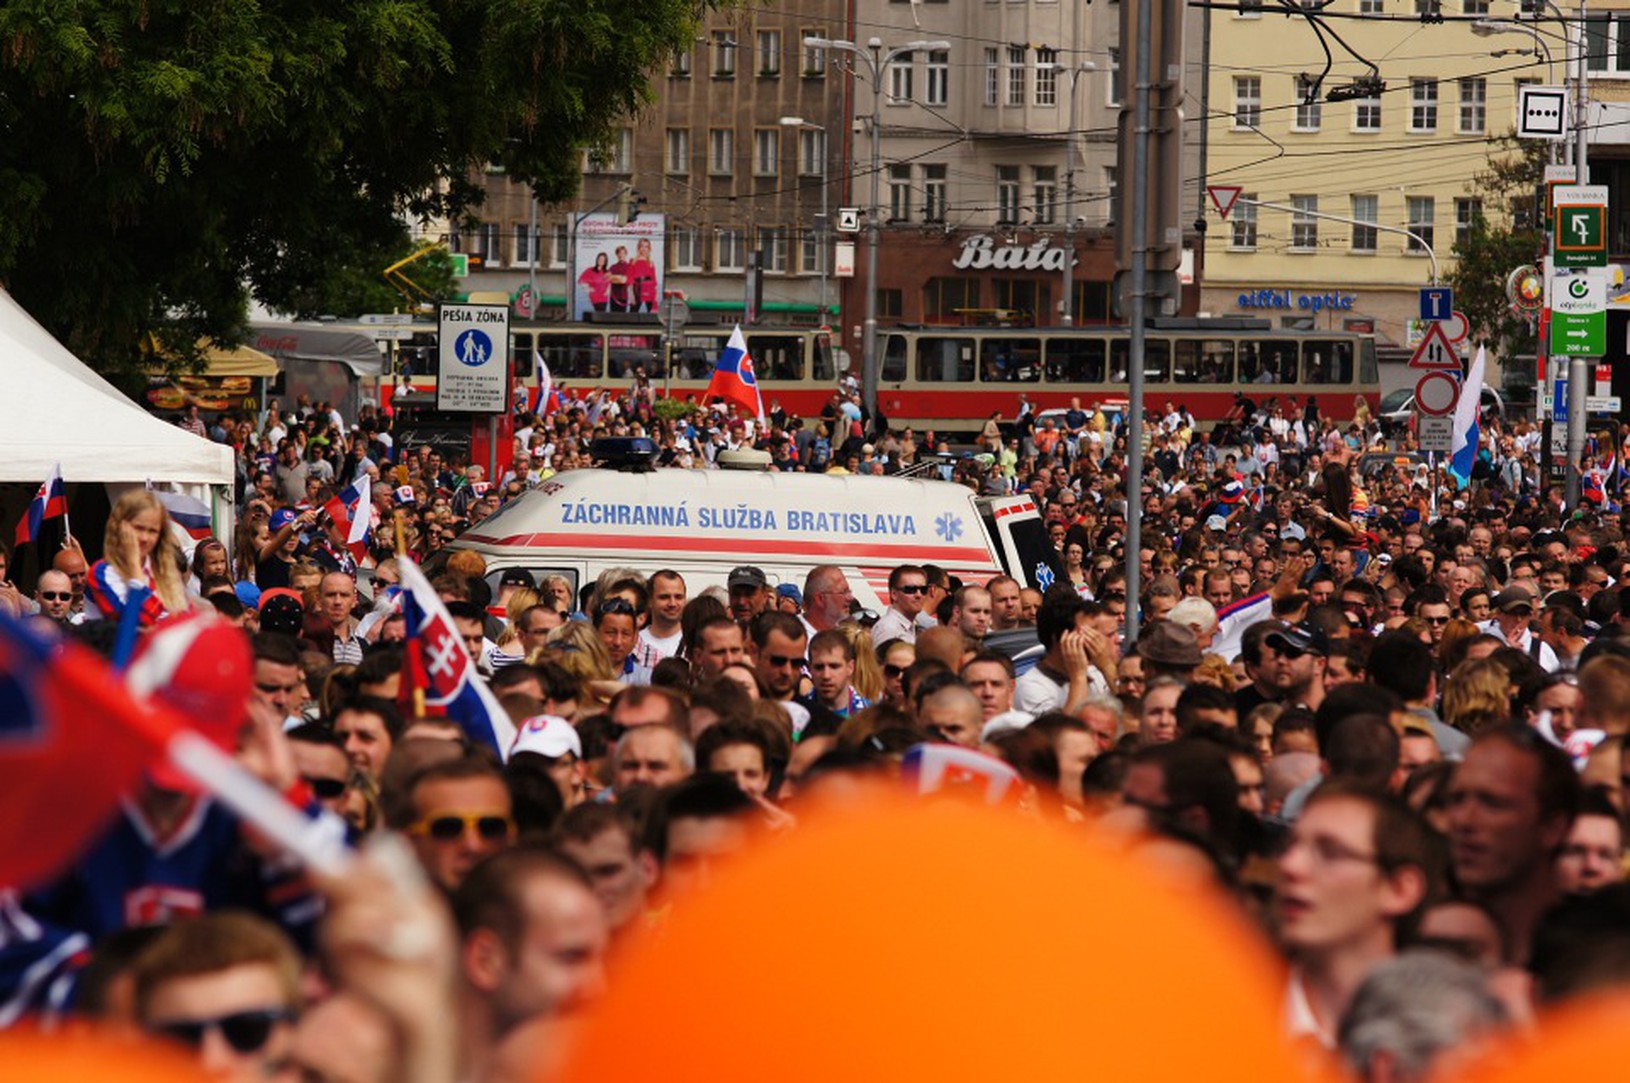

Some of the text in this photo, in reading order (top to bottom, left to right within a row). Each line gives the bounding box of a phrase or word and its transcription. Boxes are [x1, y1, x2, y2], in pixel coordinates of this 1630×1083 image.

[1237, 289, 1354, 315] eiffel optic
[442, 309, 506, 324] PEŠIA ZÓNA
[561, 497, 917, 536] ZÁCHRANNÁ SLUŽBA BRATISLAVA
